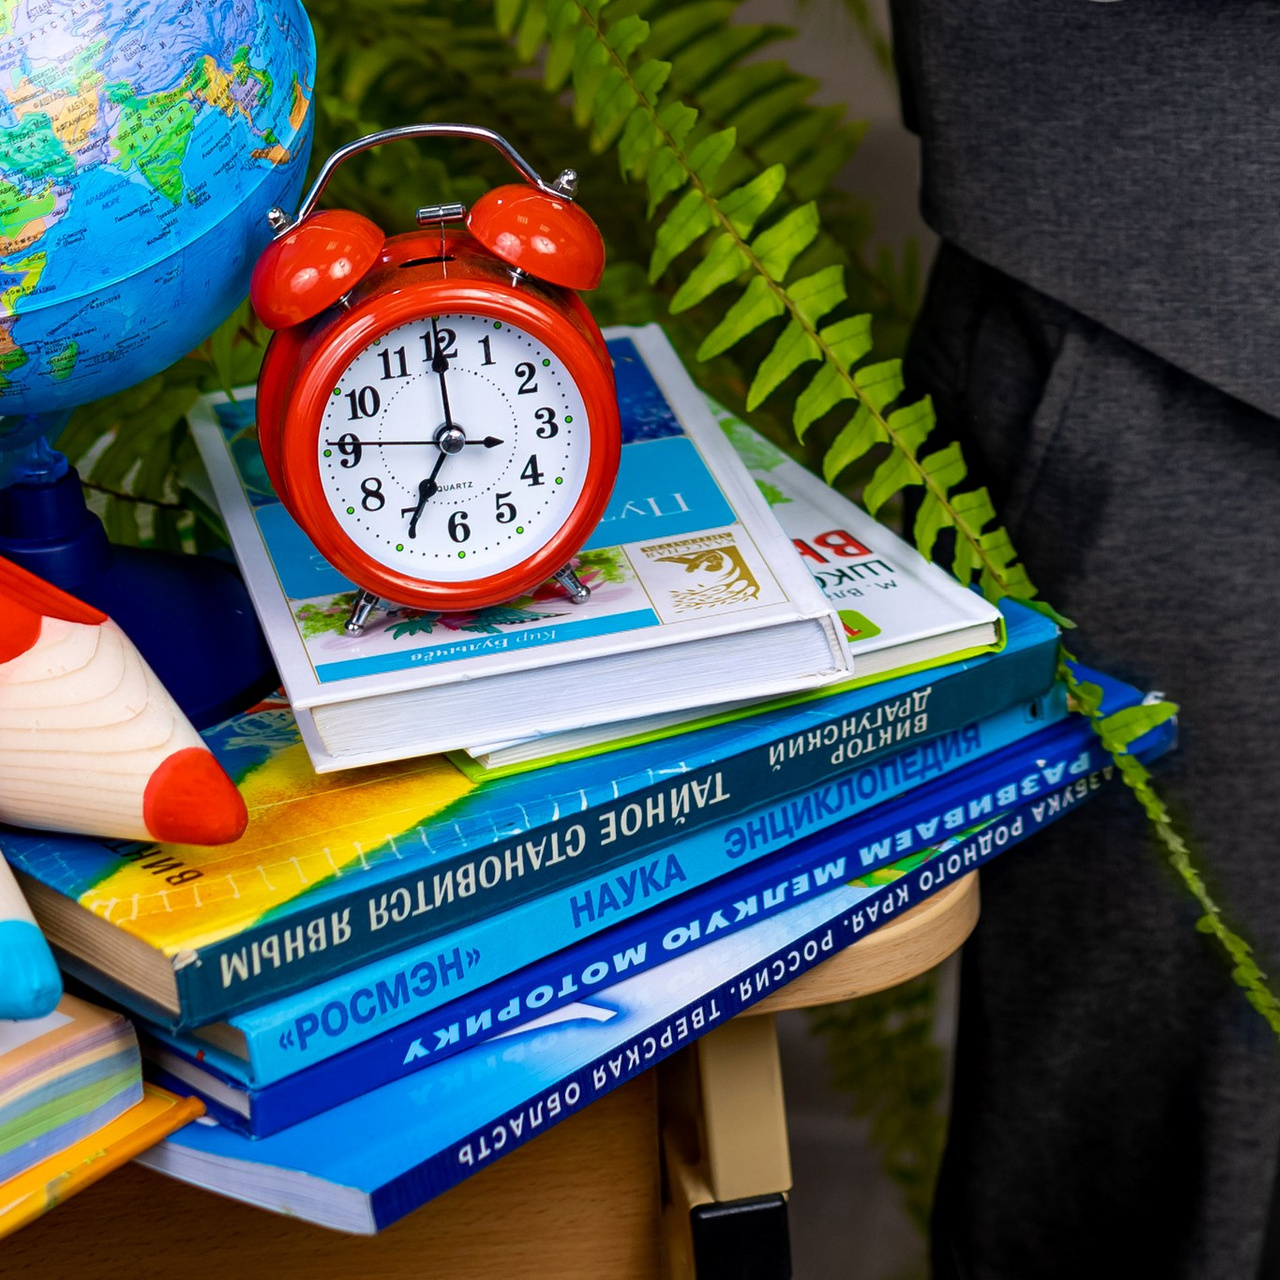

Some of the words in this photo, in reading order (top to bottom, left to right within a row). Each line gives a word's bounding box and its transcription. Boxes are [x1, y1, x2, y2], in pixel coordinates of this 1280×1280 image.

[377, 346, 412, 380] 11
[419, 327, 459, 363] 12
[478, 335, 497, 366] 1
[345, 386, 381, 421] 10
[514, 362, 538, 395] 2
[534, 406, 559, 439] 3
[337, 433, 362, 468] 9
[520, 454, 545, 487] 4
[360, 477, 386, 511] 8
[437, 481, 474, 493] QUARTZ
[495, 491, 517, 523] 5
[448, 510, 471, 543] 6
[410, 638, 509, 662] Булычёв
[516, 629, 556, 644] Кир
[769, 686, 932, 772] ДРАГУНСКИЙ
[831, 713, 928, 765] ВИКТОР
[599, 772, 731, 846] ТАЙНОЕ
[858, 751, 1091, 867] РАЗВИВАЕМ
[1031, 765, 1115, 823] АЗБУКА
[569, 852, 687, 930] НАУКА
[724, 722, 982, 860] ЭНЦИКЛОПЕДИЯ
[368, 824, 587, 933] СТАНОВИТСЯ
[919, 815, 1024, 892] РОДНОГО
[662, 856, 847, 950] МЕЛКУЮ
[843, 884, 910, 934] КРАЯ.
[219, 907, 352, 989] ЯВНЫМ
[730, 929, 834, 1002] РОССИЯ.
[279, 946, 481, 1051] «РОСМЭН»
[402, 941, 648, 1066] МОТОРИКУ
[592, 998, 721, 1091] ТВЕРСКАЯ
[457, 1081, 581, 1168] ОБЛАСТЬ
